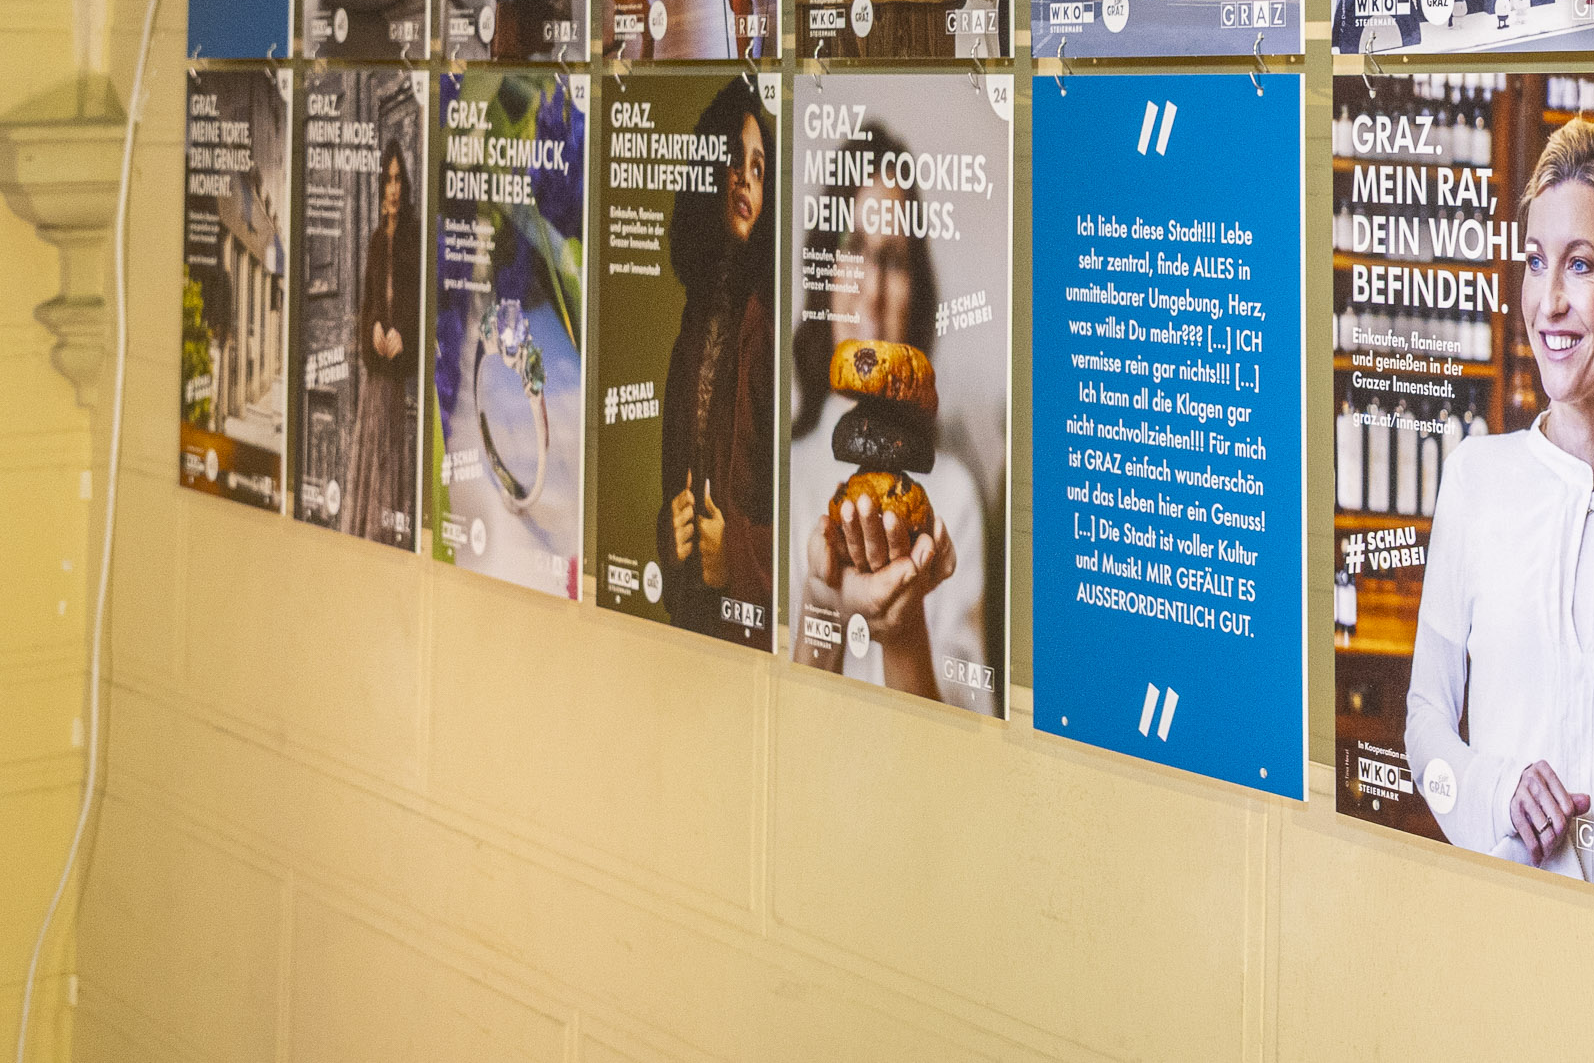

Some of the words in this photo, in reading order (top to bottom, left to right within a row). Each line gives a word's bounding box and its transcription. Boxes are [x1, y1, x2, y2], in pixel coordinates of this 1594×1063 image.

[307, 94, 340, 117] GRAZ.
[575, 86, 584, 99] 22
[764, 86, 776, 100] 23
[993, 88, 1007, 103] 24
[447, 99, 492, 130] GRAZ.
[611, 102, 655, 129] GRAZ.
[804, 104, 872, 141] GRAZ.
[610, 133, 647, 159] MEIN
[651, 133, 731, 166] FAIRTRADE,
[1352, 115, 1442, 155] GRAZ.
[446, 136, 484, 165] MEIN
[488, 138, 569, 176] SCHMUCK,
[804, 150, 874, 187] MEINE
[881, 152, 993, 199] COOKIES,
[446, 170, 488, 201] DEINE
[492, 173, 536, 206] LIEBE.
[610, 162, 643, 189] DEIN
[647, 163, 718, 193] LIFESTYLE.
[1352, 165, 1427, 205] MEIN
[1438, 168, 1499, 215] RAT,
[804, 196, 855, 233] DEIN
[862, 198, 961, 241] GENUSS.
[1077, 214, 1094, 236] Ich
[1098, 215, 1127, 238] liebe
[1131, 217, 1164, 240] diese
[1168, 219, 1216, 243] Stadt!!!
[1221, 222, 1253, 245] Lebe
[1352, 215, 1419, 256] DEIN
[1429, 219, 1537, 262] WOHL-
[1079, 247, 1103, 270] sehr
[1107, 251, 1153, 278] zentral,
[1157, 252, 1189, 276] finde
[1193, 256, 1234, 279] ALLES
[1238, 260, 1250, 280] in
[1066, 282, 1145, 307] unmittelbarer
[1149, 287, 1223, 320] Umgebung,
[1228, 294, 1266, 321] Herz,
[1352, 265, 1509, 315] BEFINDEN.
[1069, 319, 1092, 336] was
[1096, 317, 1125, 339] willst
[1129, 320, 1146, 341] Du
[1151, 322, 1202, 347] mehr???
[1236, 330, 1262, 352] ICH
[1072, 352, 1121, 373] vermisse
[1126, 355, 1149, 376] rein
[1153, 363, 1175, 383] gar
[1179, 359, 1230, 384] nichts!!!
[1079, 380, 1096, 403] Ich
[1100, 382, 1129, 407] kann
[1133, 386, 1149, 410] all
[1152, 389, 1172, 413] die
[1176, 392, 1223, 423] Klagen
[1227, 404, 1252, 427] gar
[1067, 415, 1094, 436] nicht
[1098, 419, 1204, 452] nachvollziehen!!!
[1209, 432, 1230, 456] Für
[1235, 437, 1266, 460] mich
[1069, 447, 1081, 467] ist
[1084, 449, 1121, 474] GRAZ
[1125, 456, 1171, 482] einfach
[1175, 465, 1264, 495] wunderschön
[1067, 481, 1089, 502] und
[1093, 483, 1114, 507] das
[1118, 488, 1154, 513] Leben
[1158, 493, 1183, 518] hier
[1187, 501, 1207, 523] ein
[1211, 503, 1265, 532] Genuss!
[1100, 518, 1119, 542] Die
[1124, 523, 1156, 548] Stadt
[1160, 530, 1173, 551] ist
[1177, 533, 1214, 558] voller
[1218, 540, 1258, 566] Kultur
[1076, 550, 1098, 572] und
[1102, 553, 1141, 580] Musik!
[1146, 562, 1172, 586] MIR
[1176, 568, 1234, 598] GEFÄLLT
[1238, 580, 1255, 602] ES
[1076, 582, 1215, 629] AUSSERORDENTLICH
[1220, 611, 1255, 638] GUT.
